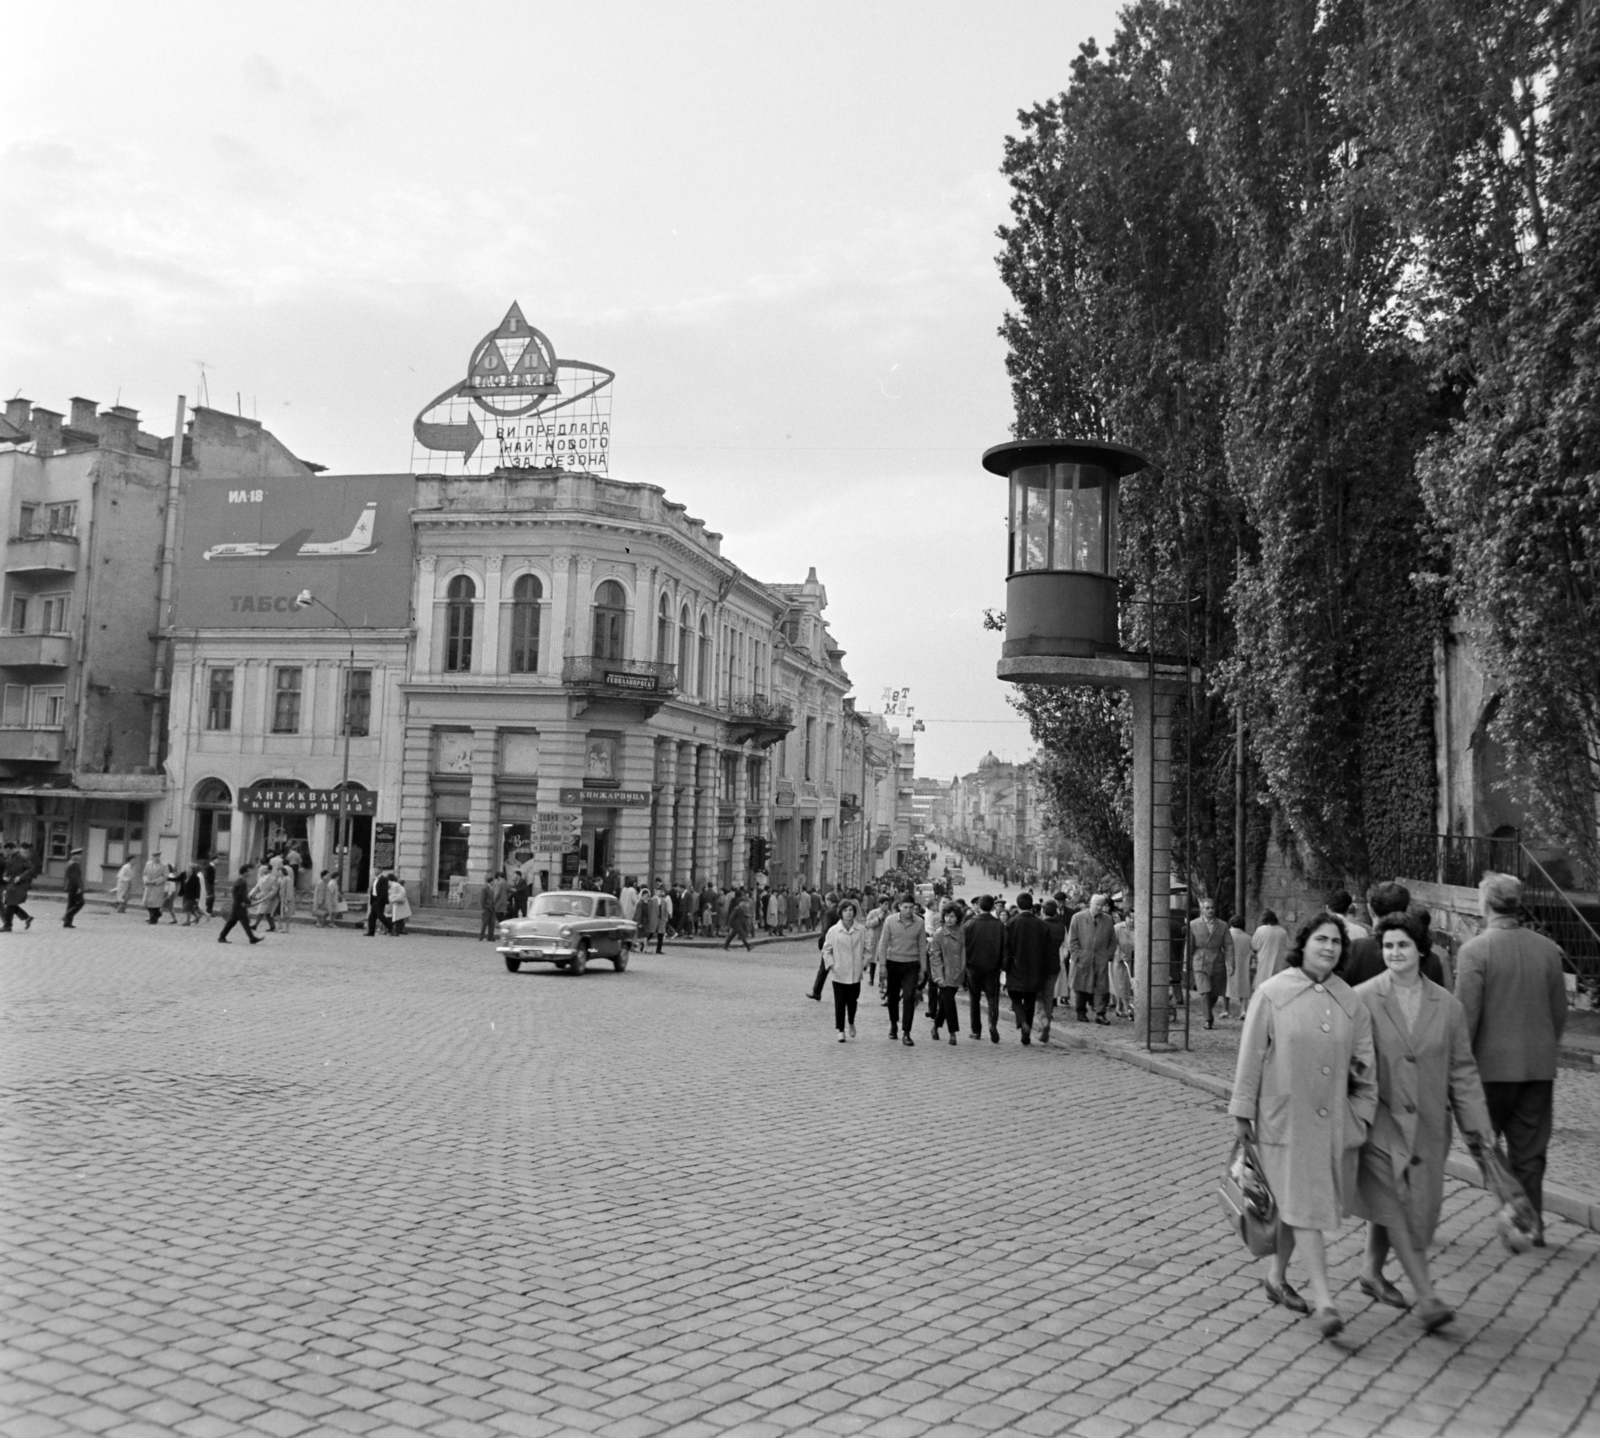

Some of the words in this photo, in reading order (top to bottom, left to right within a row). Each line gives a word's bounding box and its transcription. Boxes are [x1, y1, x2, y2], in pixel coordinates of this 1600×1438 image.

[496, 426, 516, 439] ВИ
[525, 422, 609, 437] ПРЕДЛАГА
[513, 457, 531, 468] ЗА
[544, 454, 606, 468] СЕЗОНА
[579, 791, 645, 801] КНИЖАРНИЦА
